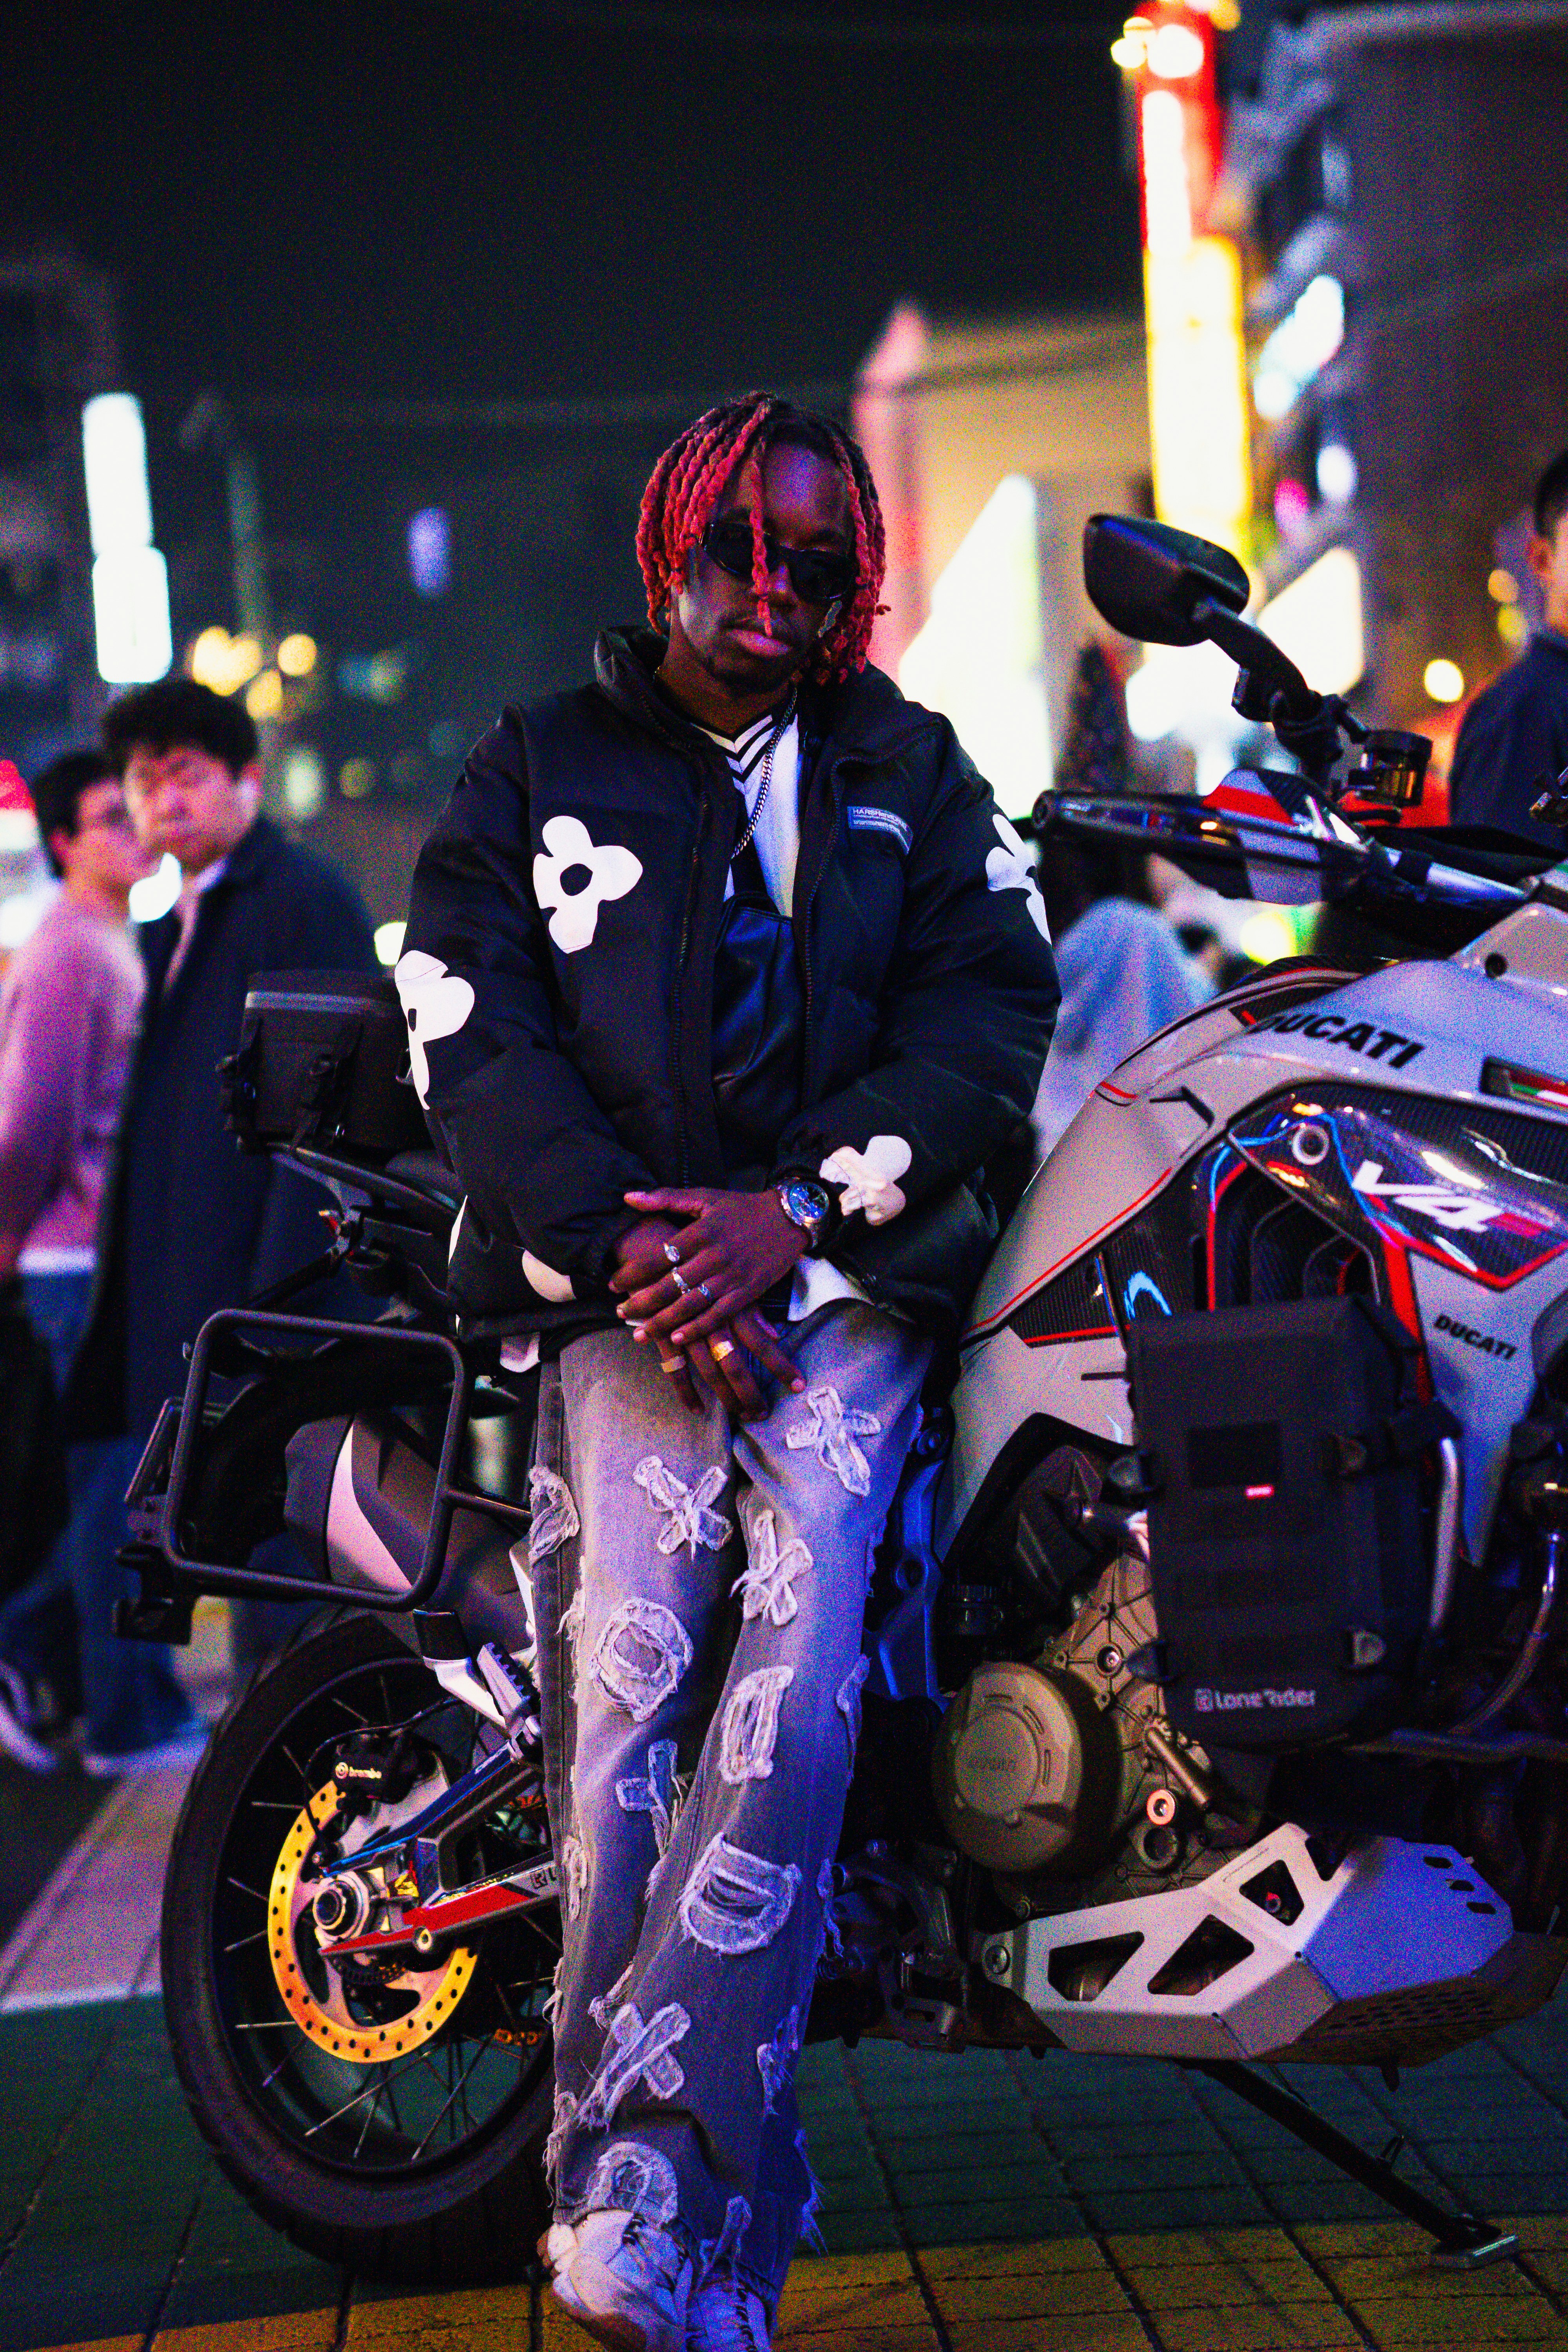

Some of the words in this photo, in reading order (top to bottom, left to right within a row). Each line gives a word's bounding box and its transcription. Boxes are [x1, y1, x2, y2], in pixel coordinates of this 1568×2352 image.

[1247, 1014, 1425, 1069] DUCATI
[1351, 1159, 1503, 1233] V4
[1434, 1314, 1517, 1361] DUCATI
[349, 1766, 382, 1779] brembo
